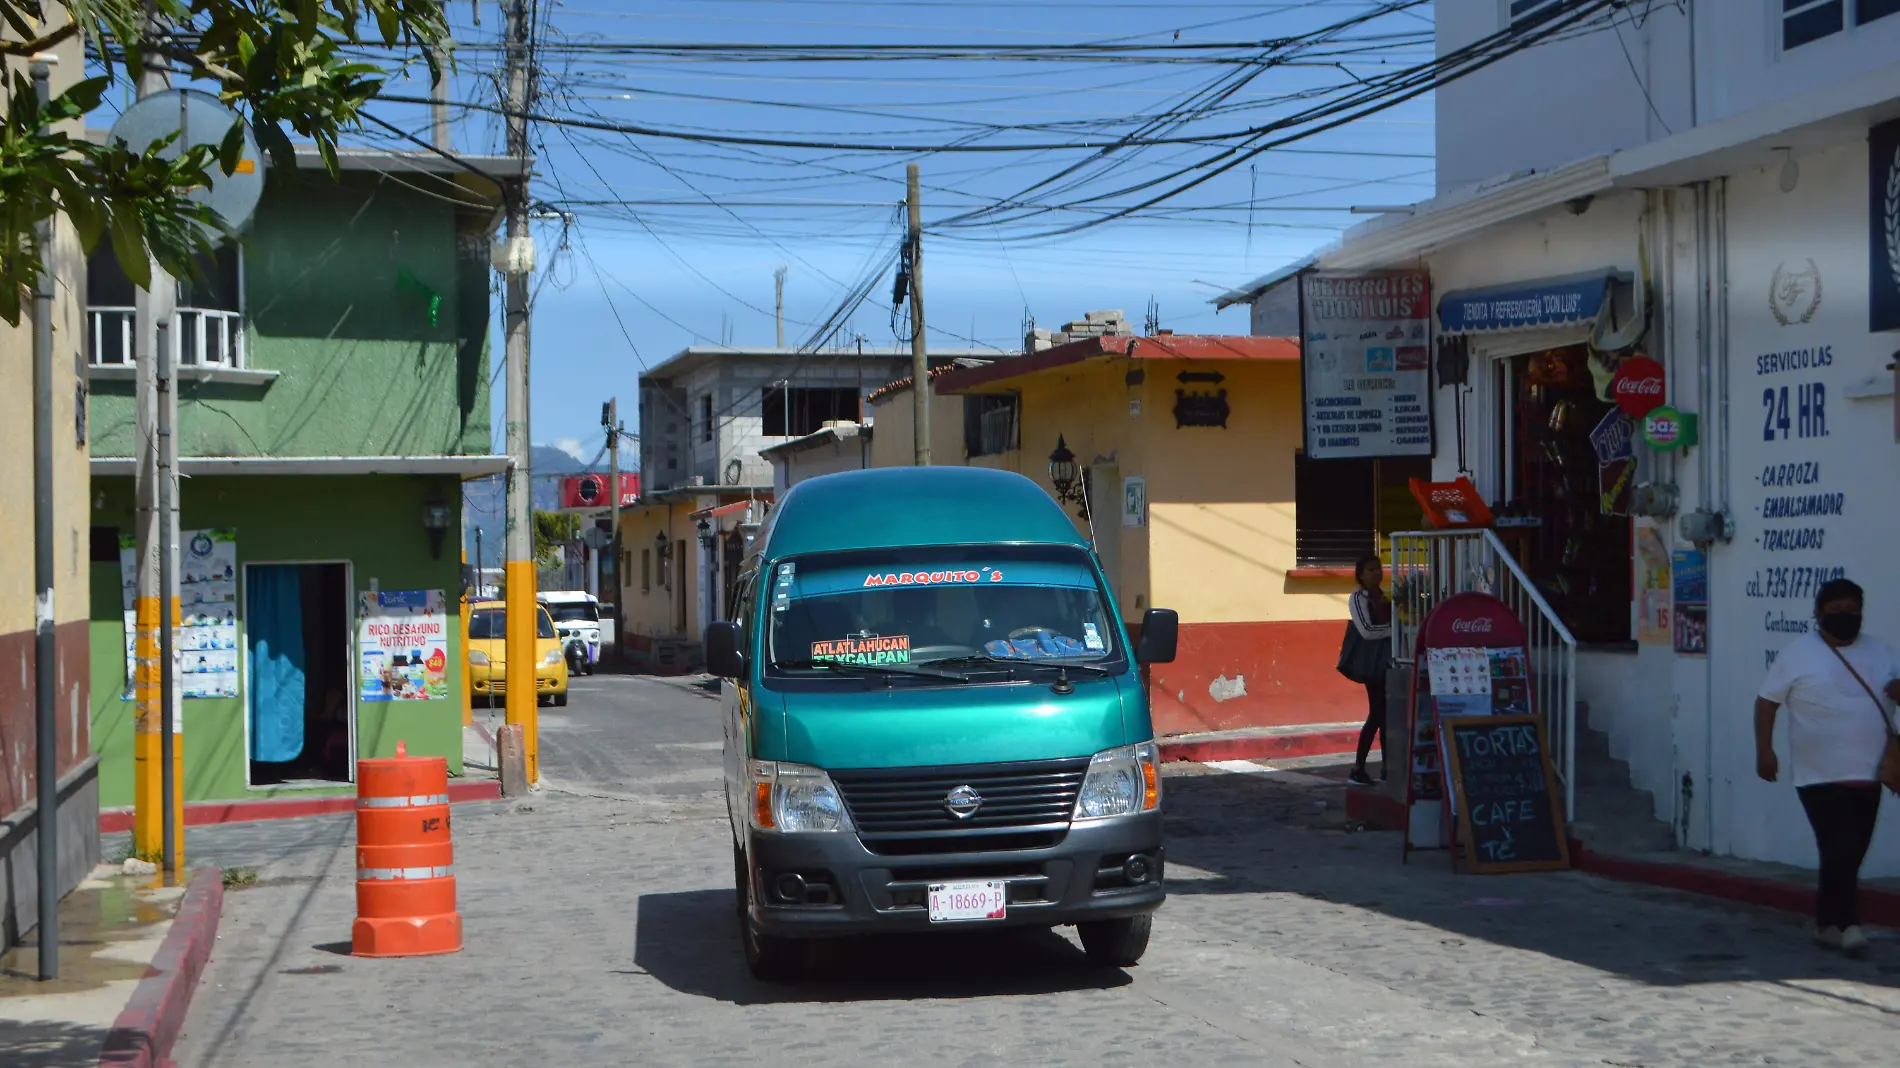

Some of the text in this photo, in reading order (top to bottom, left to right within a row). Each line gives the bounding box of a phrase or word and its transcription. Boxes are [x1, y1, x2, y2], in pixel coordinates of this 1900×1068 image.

[1309, 275, 1424, 297] ABARROTES
[1464, 302, 1488, 320] TIENDITA
[1496, 296, 1542, 319] REFRESQUERÍA
[1757, 345, 1833, 375] SERVICIO LAS
[1616, 377, 1662, 394] Coca-Cola
[1763, 382, 1830, 442] 24 HR.
[1646, 417, 1680, 432] baz
[1762, 462, 1819, 487] CARROZA
[1763, 493, 1844, 518] EMBALSAMADOR
[1763, 529, 1825, 551] TRASLADOS
[368, 623, 440, 636] RICO DESAYUNO
[1452, 617, 1493, 633] Coca-Cola
[1765, 611, 1808, 634] Contamos
[380, 636, 426, 648] NUTRITIVO
[814, 638, 908, 655] ATLATLAHUCAN
[1456, 726, 1539, 759] TORTAS
[1471, 800, 1537, 826] CAFE
[931, 892, 1003, 911] A-18669-P
